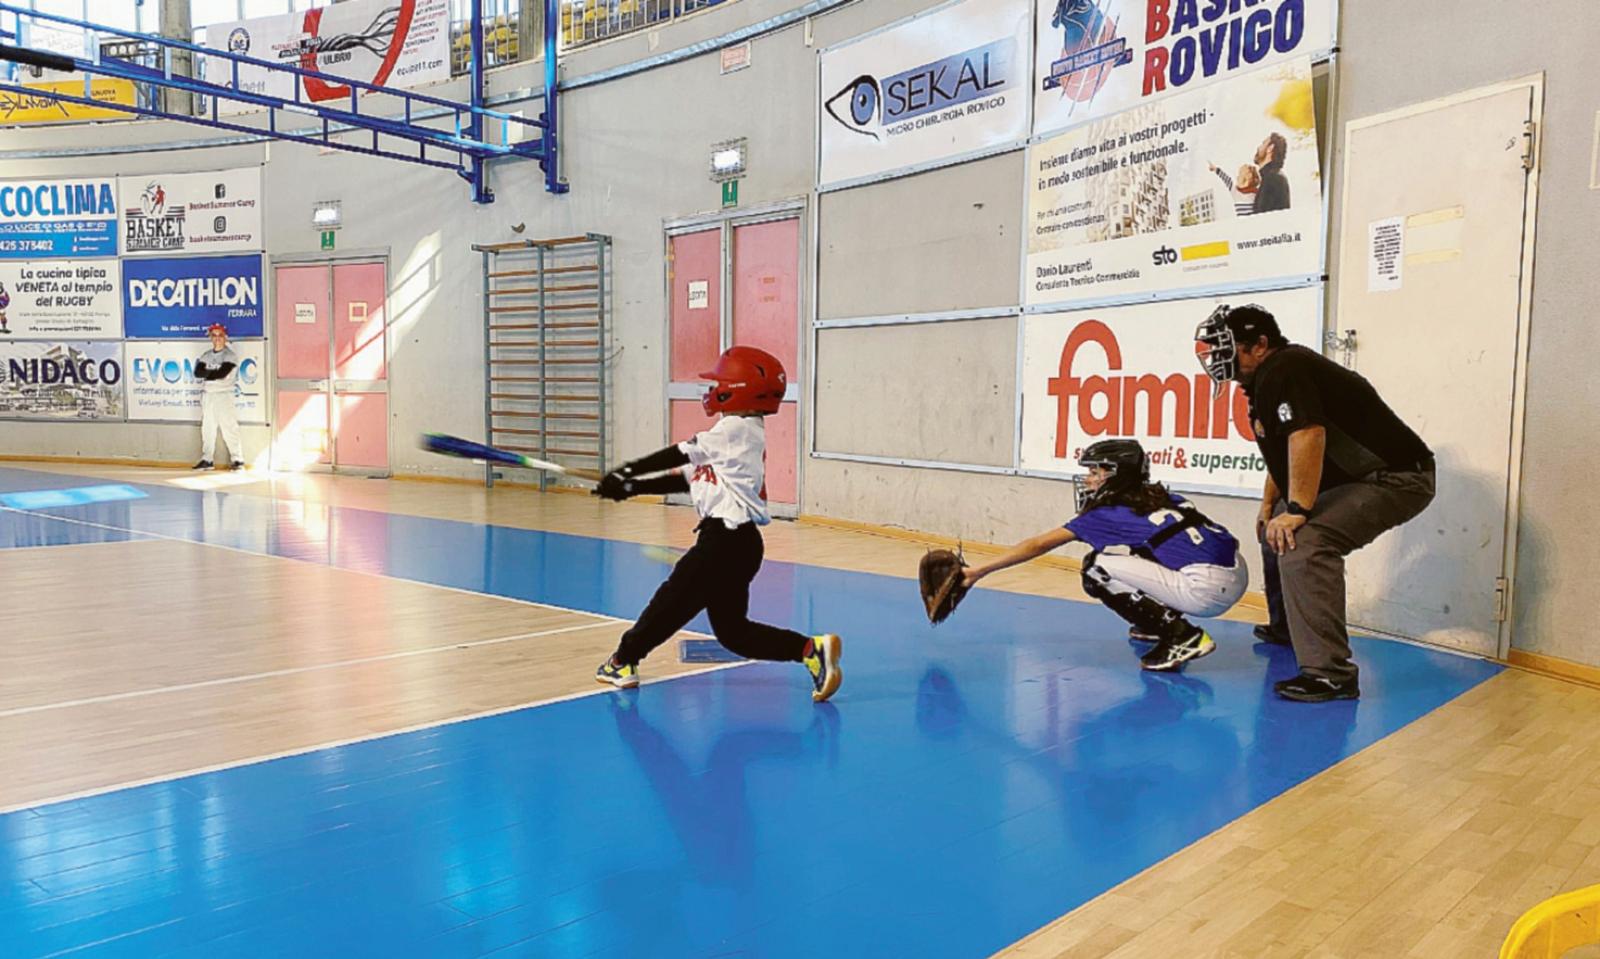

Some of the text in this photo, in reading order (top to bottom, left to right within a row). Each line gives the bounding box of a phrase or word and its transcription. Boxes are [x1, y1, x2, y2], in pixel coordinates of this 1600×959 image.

[1142, 0, 1305, 97] ROVIGO
[887, 52, 1005, 116] SEKAL
[886, 96, 1005, 136] MICRO CHIRURGIA ROVIGO
[1040, 108, 1207, 171] Insieme diamo vita ai vostri progetti
[1038, 140, 1188, 190] in modo sostenibile e funzionale.
[126, 217, 185, 238] BASKET
[126, 237, 185, 249] SUMMER CAMP
[1152, 245, 1178, 266] sto
[21, 267, 106, 280] La cucina tipica
[1070, 274, 1094, 286] Tecnico
[1095, 269, 1140, 282] Commerciale
[15, 280, 113, 294] VENETA al tempio
[129, 277, 257, 307] DECATHLON
[36, 296, 94, 307] del RUGBY
[227, 309, 256, 318] FERRARA
[8, 358, 120, 385] NIDACO
[1173, 447, 1188, 468] &
